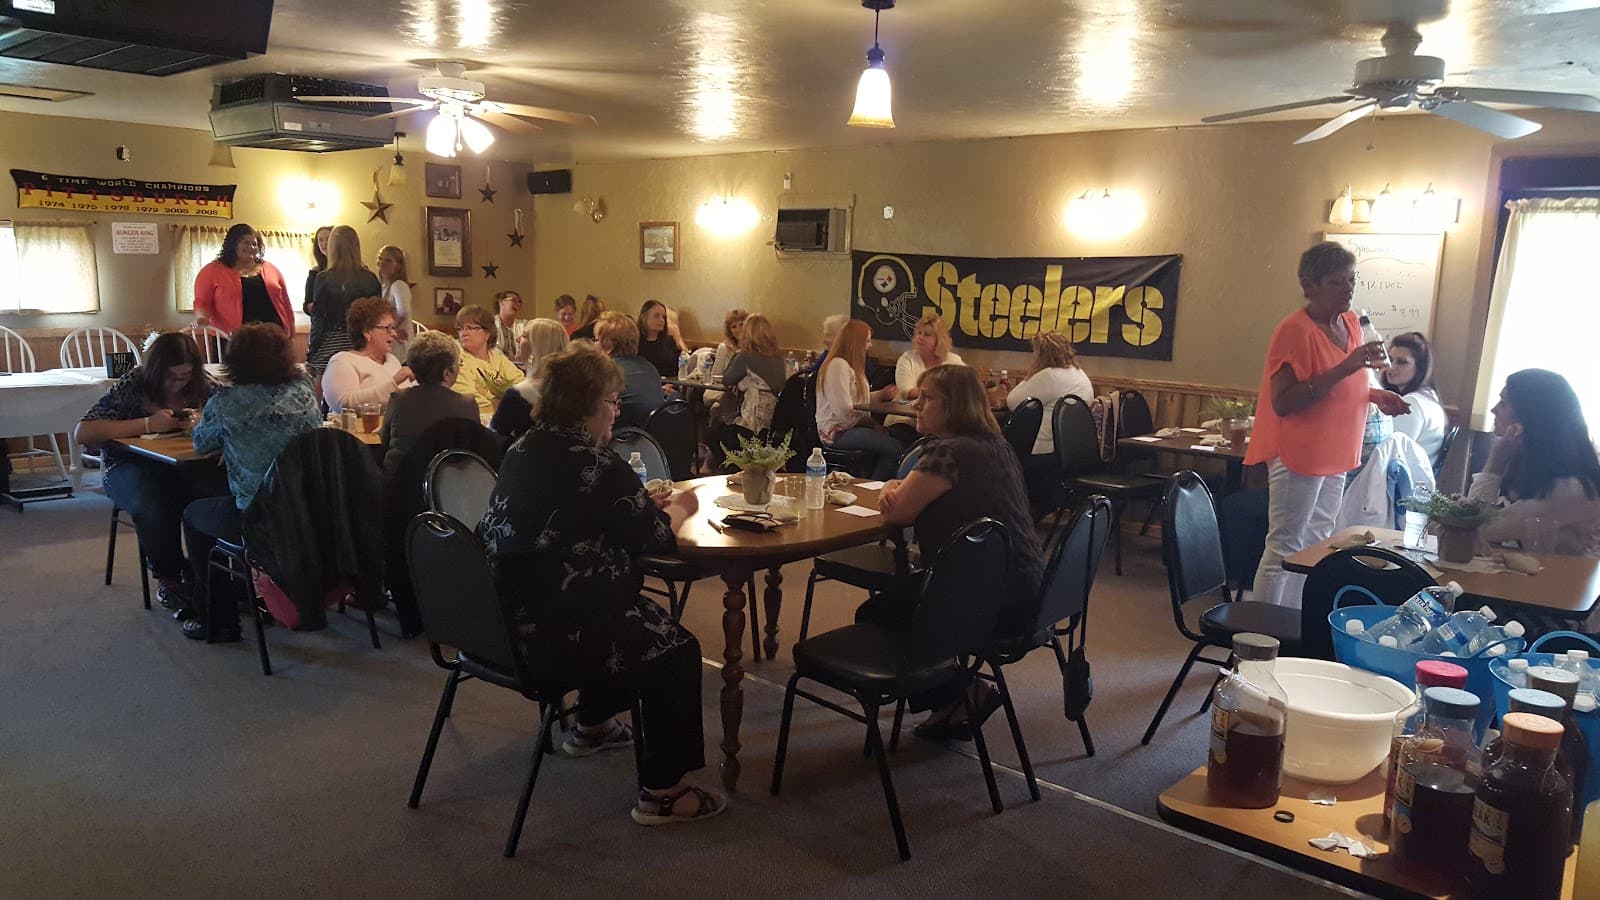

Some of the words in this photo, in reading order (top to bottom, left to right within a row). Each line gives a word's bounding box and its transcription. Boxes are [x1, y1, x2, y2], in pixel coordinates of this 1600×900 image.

[58, 176, 89, 186] TIME
[97, 178, 137, 188] WORLD
[145, 182, 210, 192] CHAMPIONS
[23, 182, 229, 207] PITTSBURGH
[39, 200, 65, 208] 1974
[72, 202, 98, 210] 1975
[105, 204, 130, 212] 1978
[164, 207, 189, 215] 2005
[195, 208, 218, 216] 2008
[922, 260, 1164, 347] Steelers
